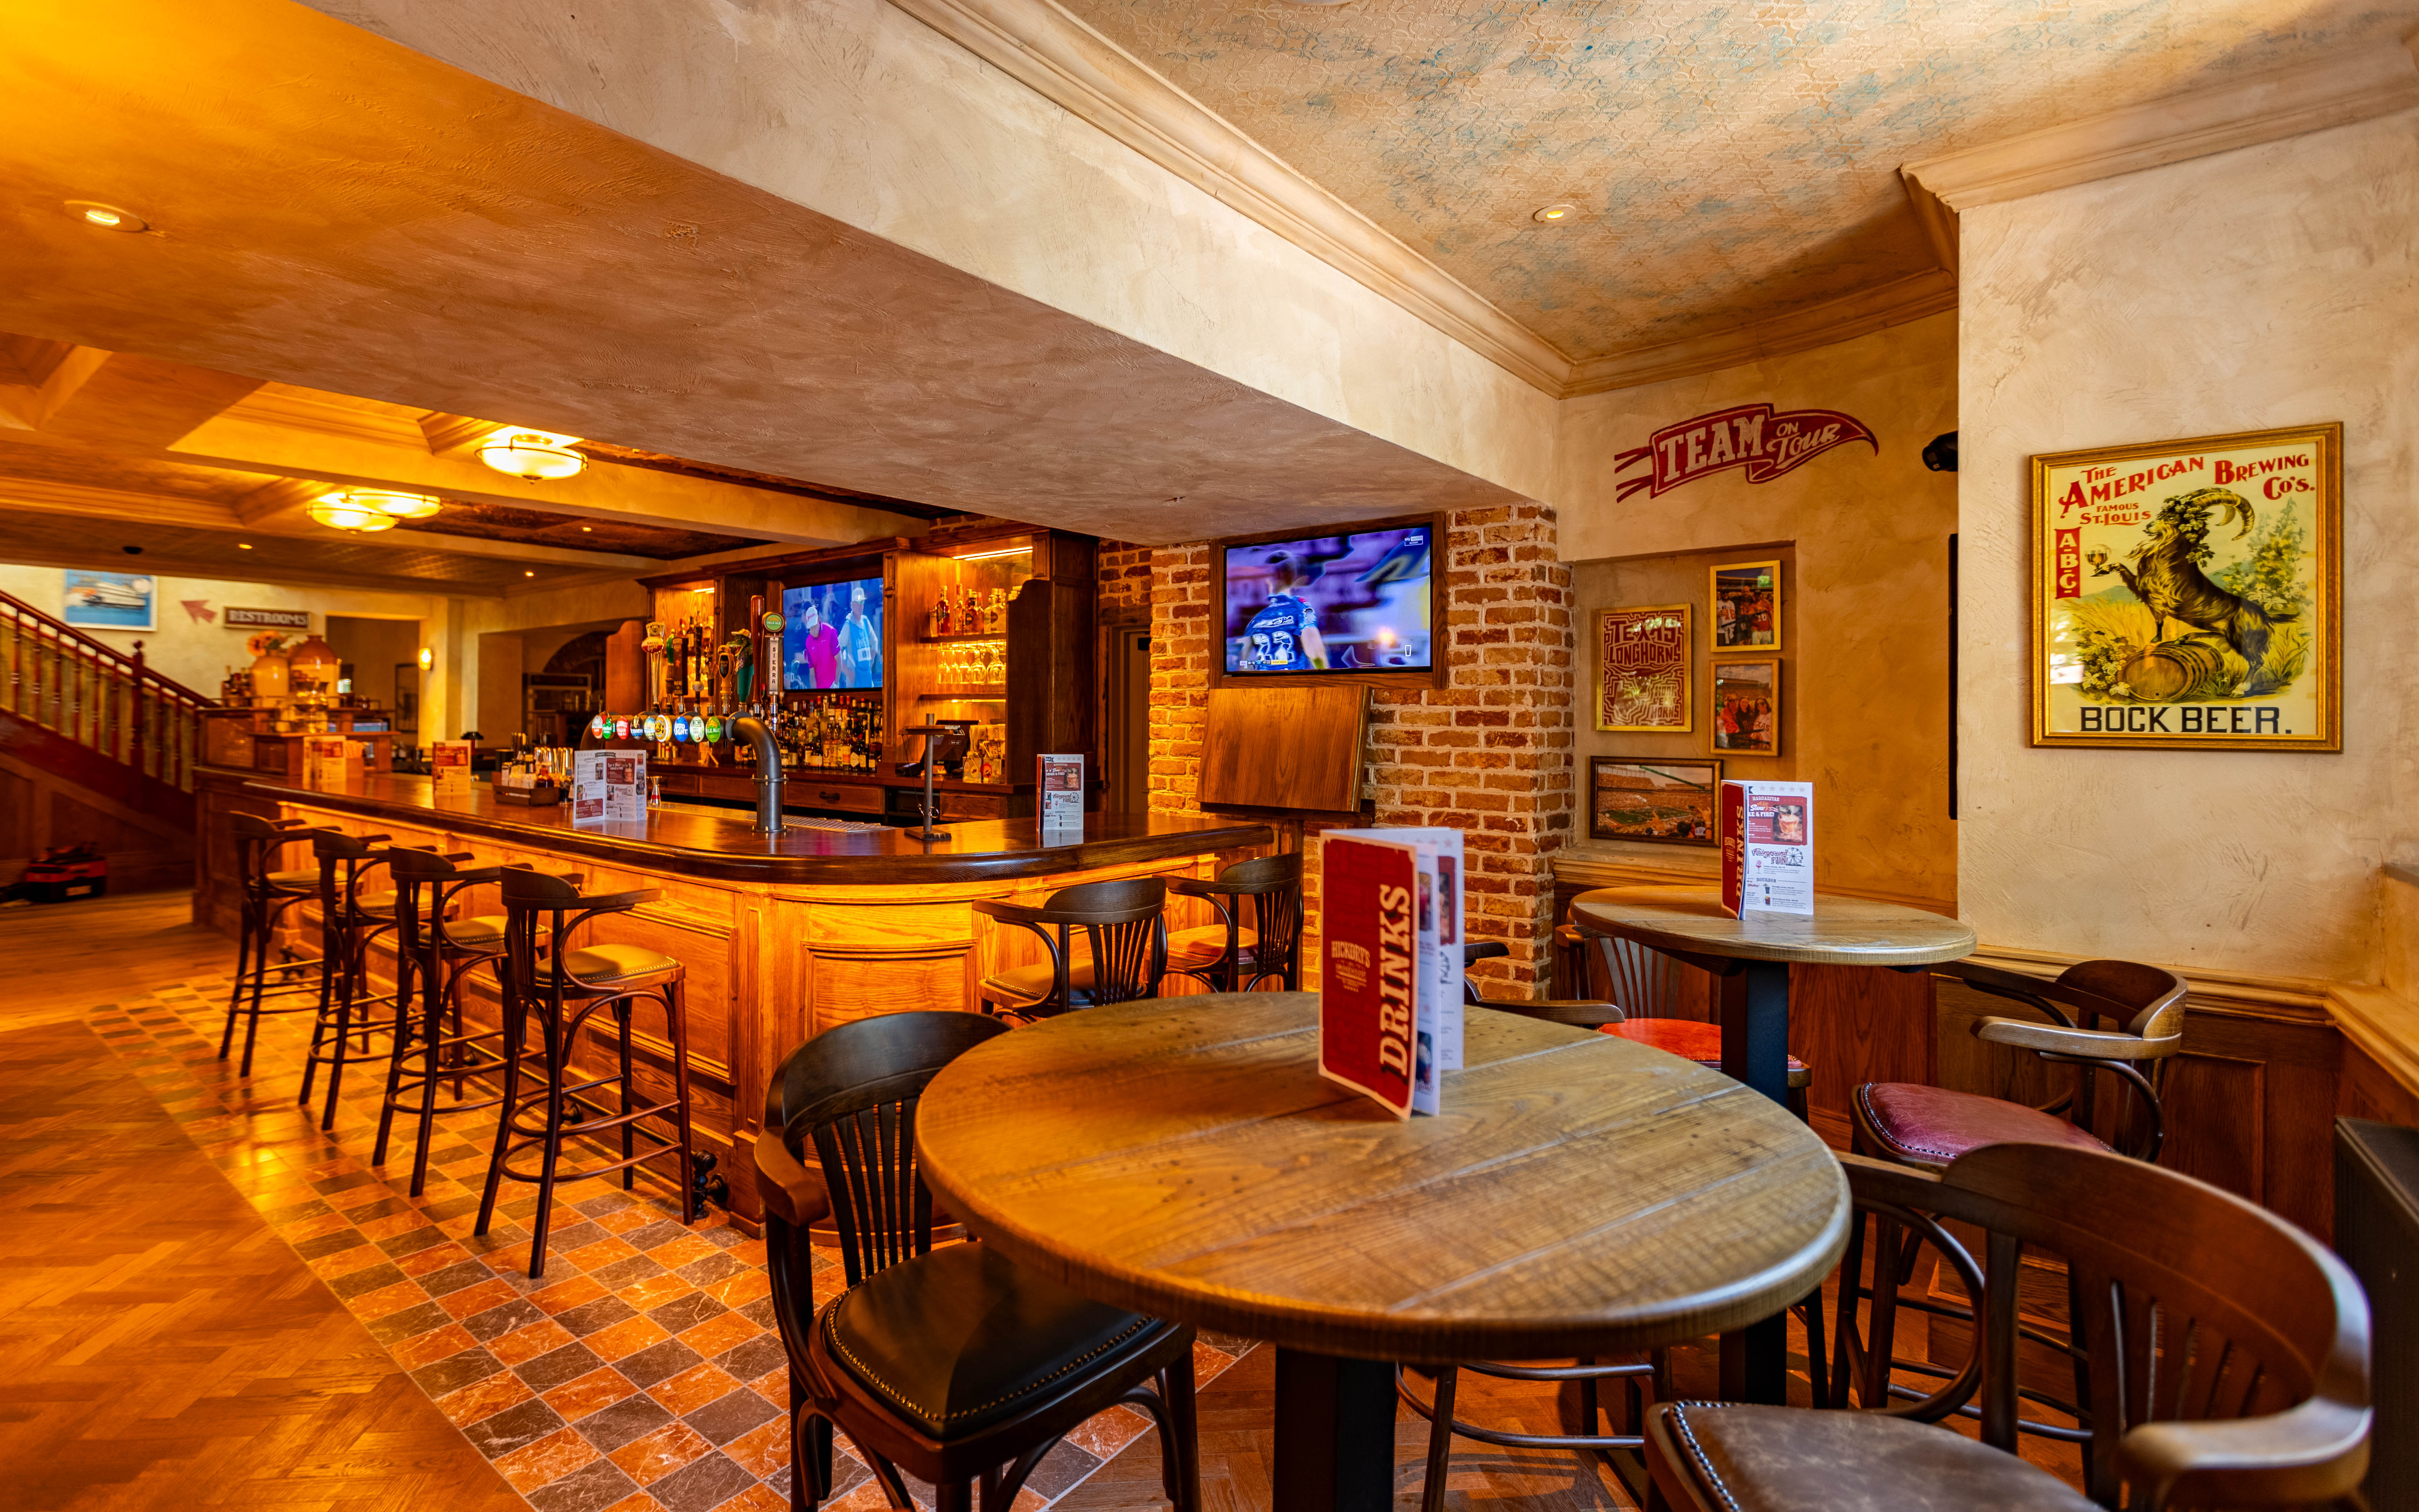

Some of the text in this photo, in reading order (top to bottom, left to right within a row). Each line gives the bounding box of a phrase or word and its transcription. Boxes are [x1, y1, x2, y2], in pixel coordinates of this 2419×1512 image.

[1659, 414, 1841, 482] TEAM ON TOUR
[2058, 454, 2309, 518] AMERICAN BREWING
[2081, 466, 2117, 484] THE
[2096, 502, 2139, 513] FAMOUS
[229, 610, 307, 625] RESTROOMS
[1609, 642, 1680, 665] LONGHORNS
[1651, 705, 1679, 719] HORNS
[2080, 706, 2292, 734] BOCK BEER.
[1751, 848, 1788, 858] Fairground
[1331, 941, 1370, 968] HICKORY'S
[1379, 883, 1410, 1077] DRINKS
